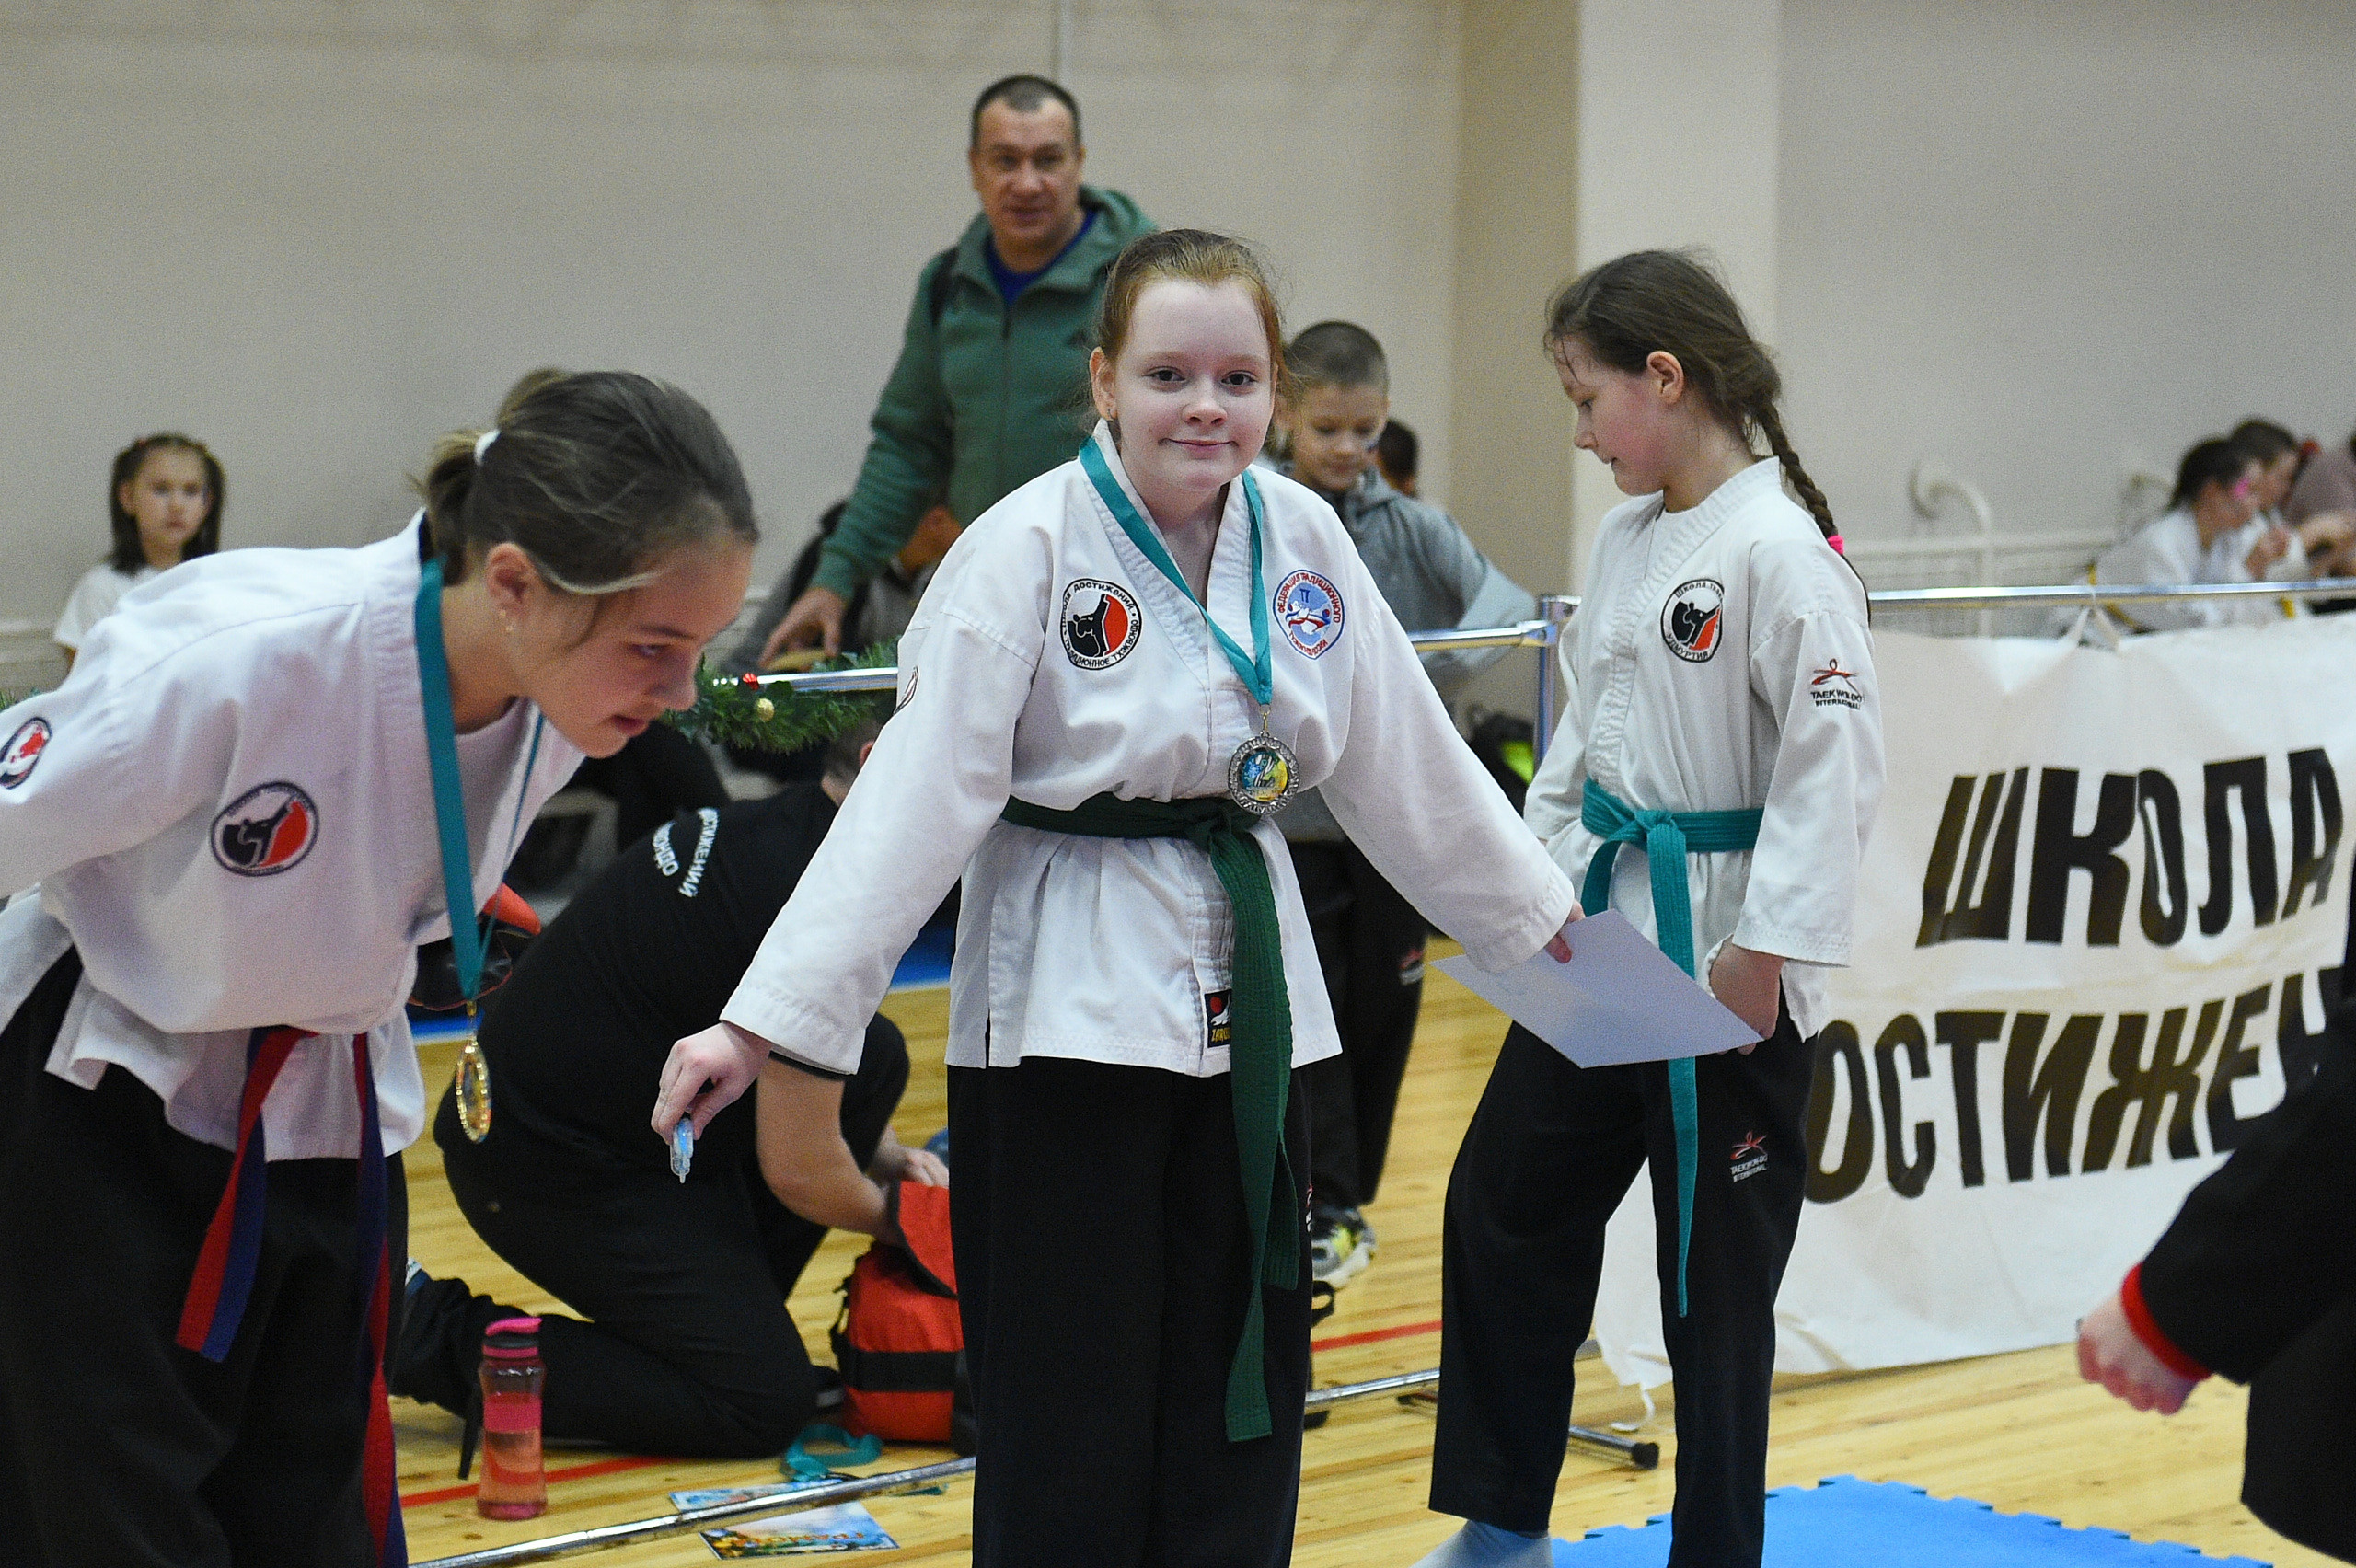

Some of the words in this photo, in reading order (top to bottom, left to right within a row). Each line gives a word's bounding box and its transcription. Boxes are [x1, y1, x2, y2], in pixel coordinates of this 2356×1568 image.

[1112, 620, 1138, 662] ТХЭКВОНДО
[1277, 573, 1300, 613] ФЕДЕРАЦИЯ
[1915, 748, 2345, 949] ШКОЛА
[1803, 967, 2346, 1204] ОСТИЖЕН
